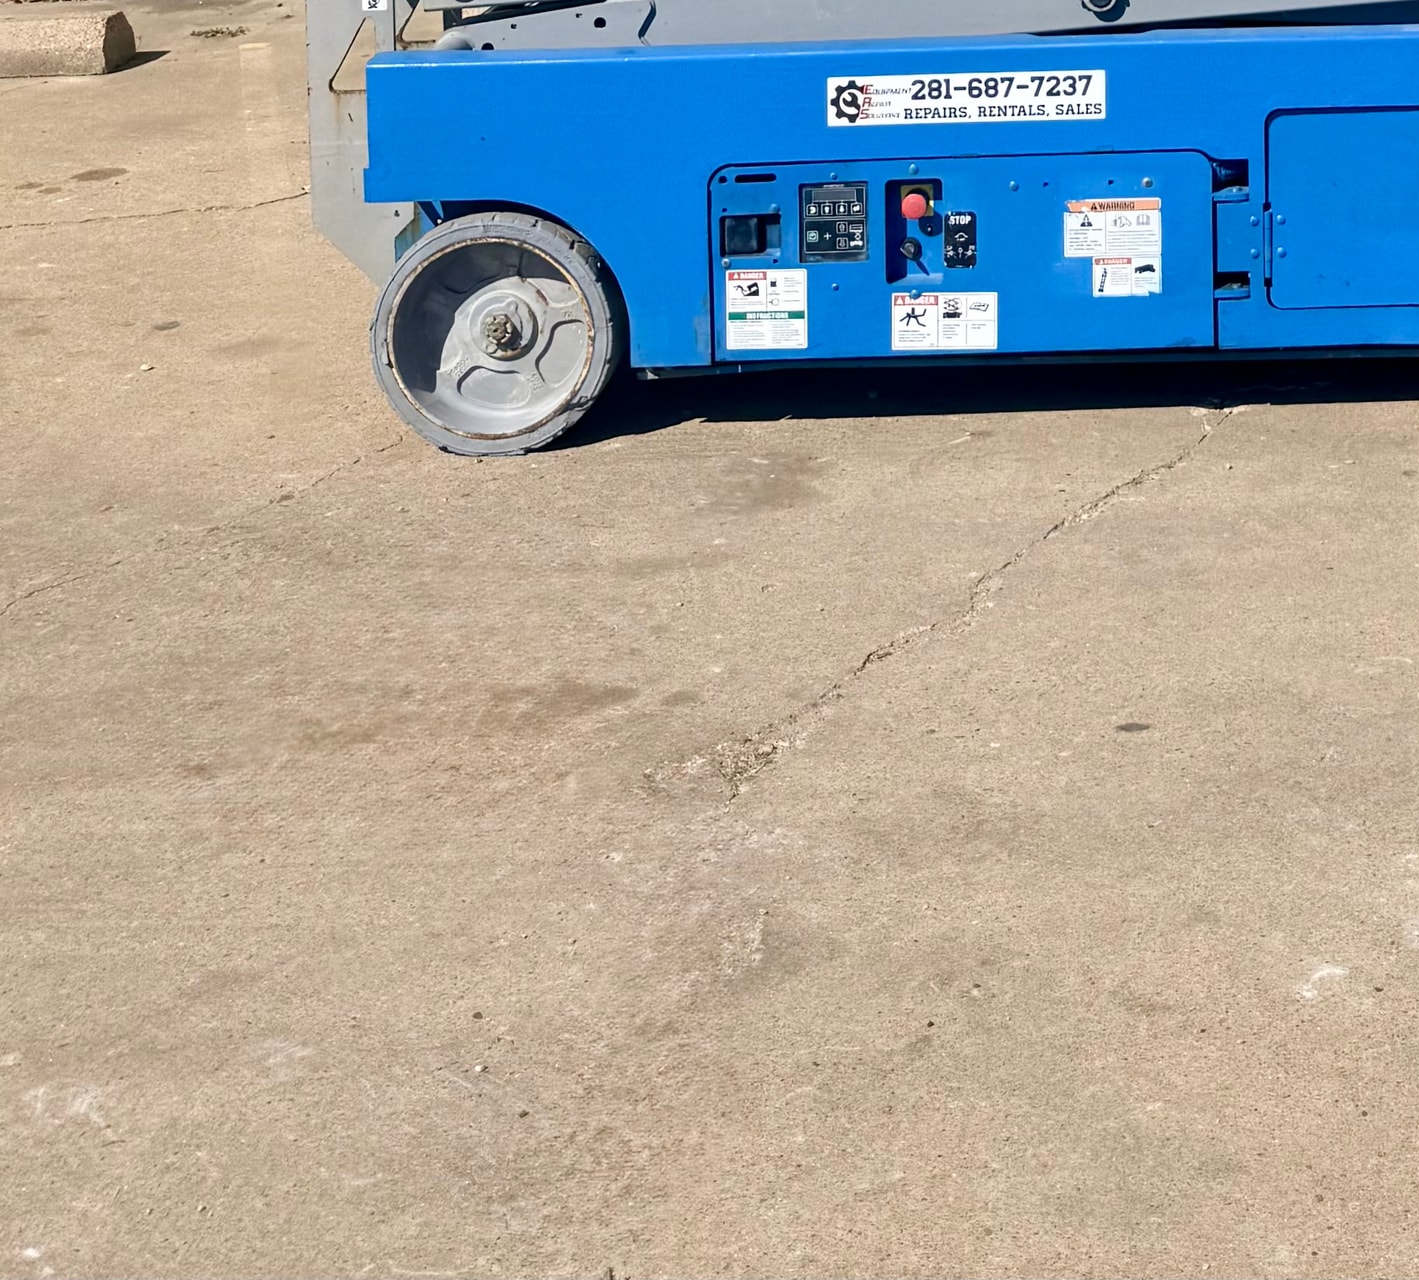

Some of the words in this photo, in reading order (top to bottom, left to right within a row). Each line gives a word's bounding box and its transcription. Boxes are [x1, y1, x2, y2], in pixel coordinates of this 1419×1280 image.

[911, 75, 1093, 100] 281-687-7237
[904, 106, 972, 120] REPAIRS,
[977, 104, 1050, 118] RENTALS,
[1055, 103, 1102, 116] SALES
[1099, 201, 1135, 210] WARNING
[949, 215, 971, 225] STOP
